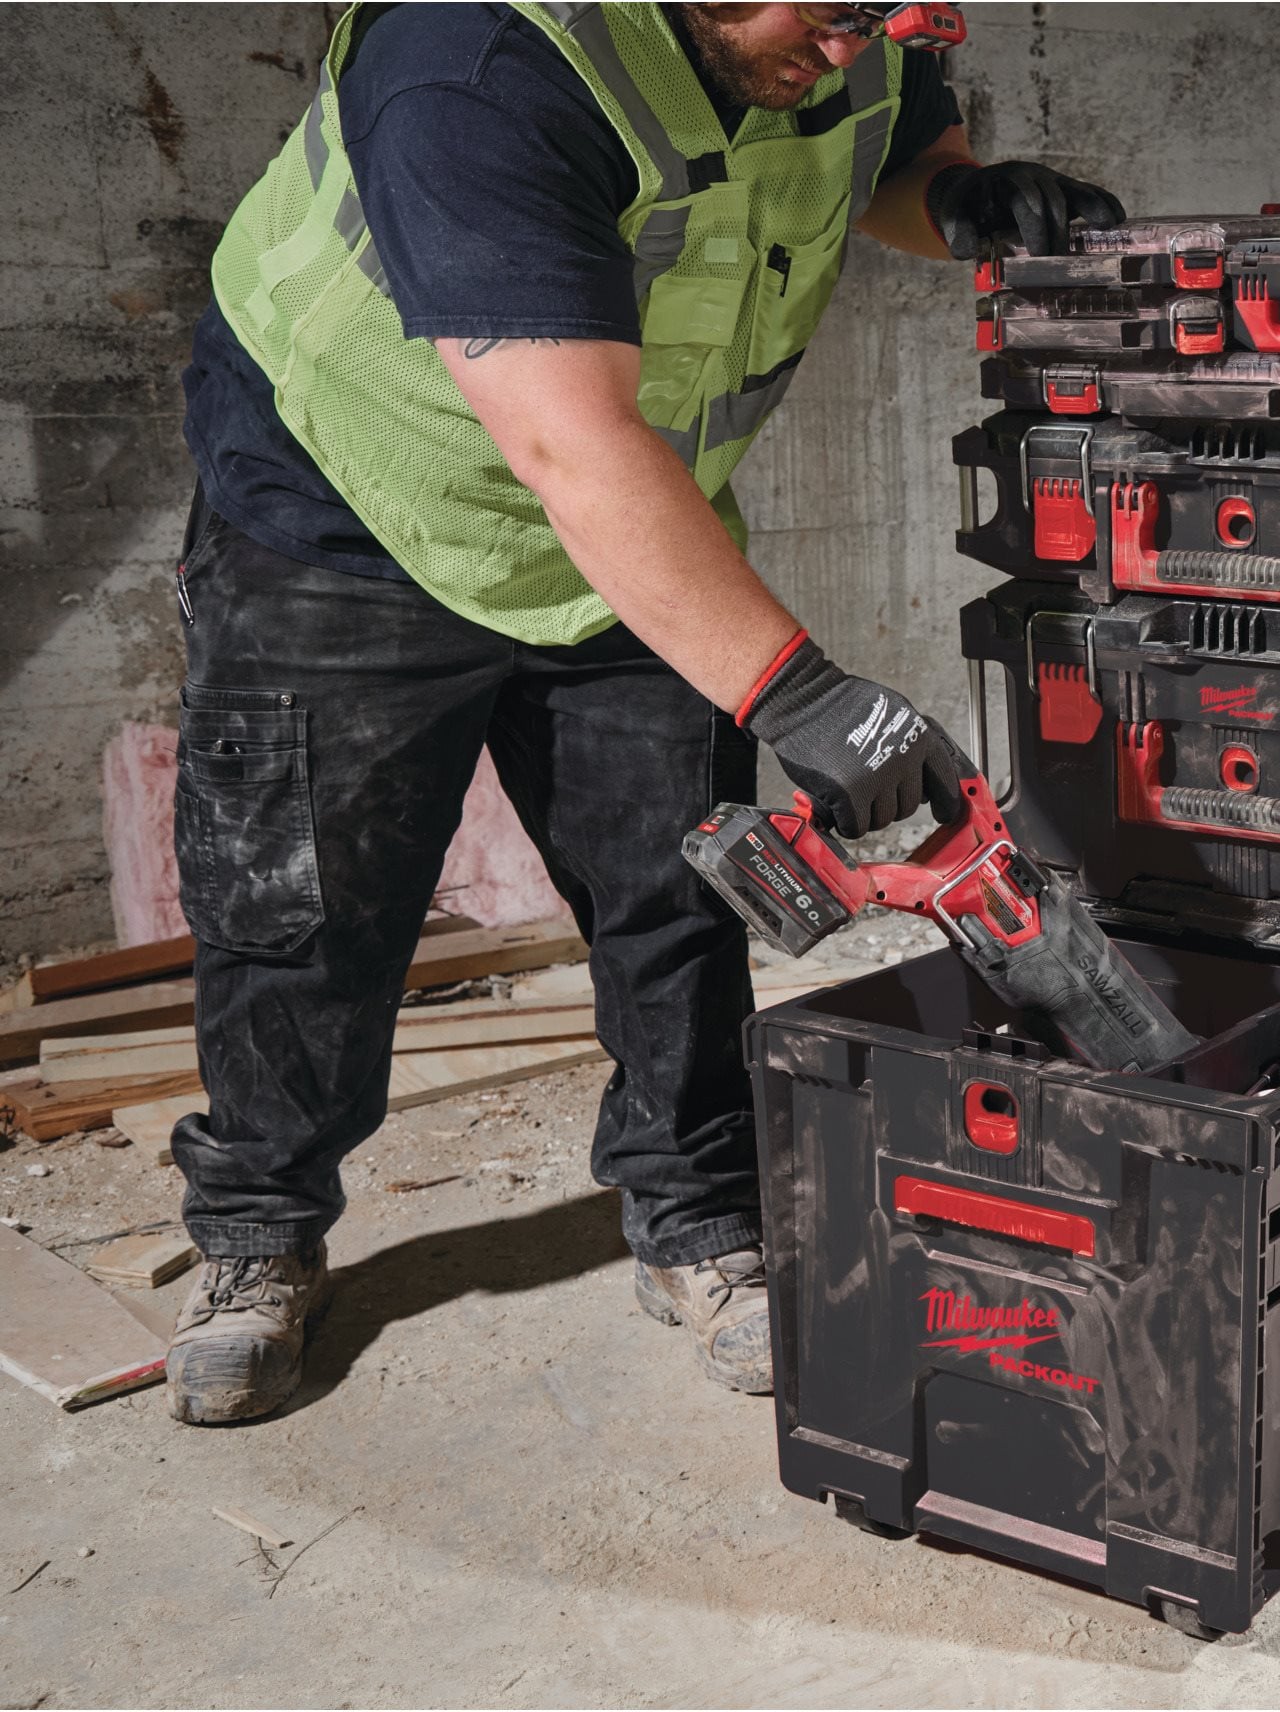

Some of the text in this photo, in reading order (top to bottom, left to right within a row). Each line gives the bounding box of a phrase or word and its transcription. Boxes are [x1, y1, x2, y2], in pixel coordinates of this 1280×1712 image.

[1199, 685, 1257, 705] Milwaukee
[846, 694, 885, 747] Milwaukee
[750, 855, 792, 898] FORGE
[796, 895, 819, 921] 6.0
[1078, 955, 1141, 1036] SAWZALL
[918, 1286, 1062, 1333] Milwaukee
[989, 1352, 1101, 1395] PACKOUT
